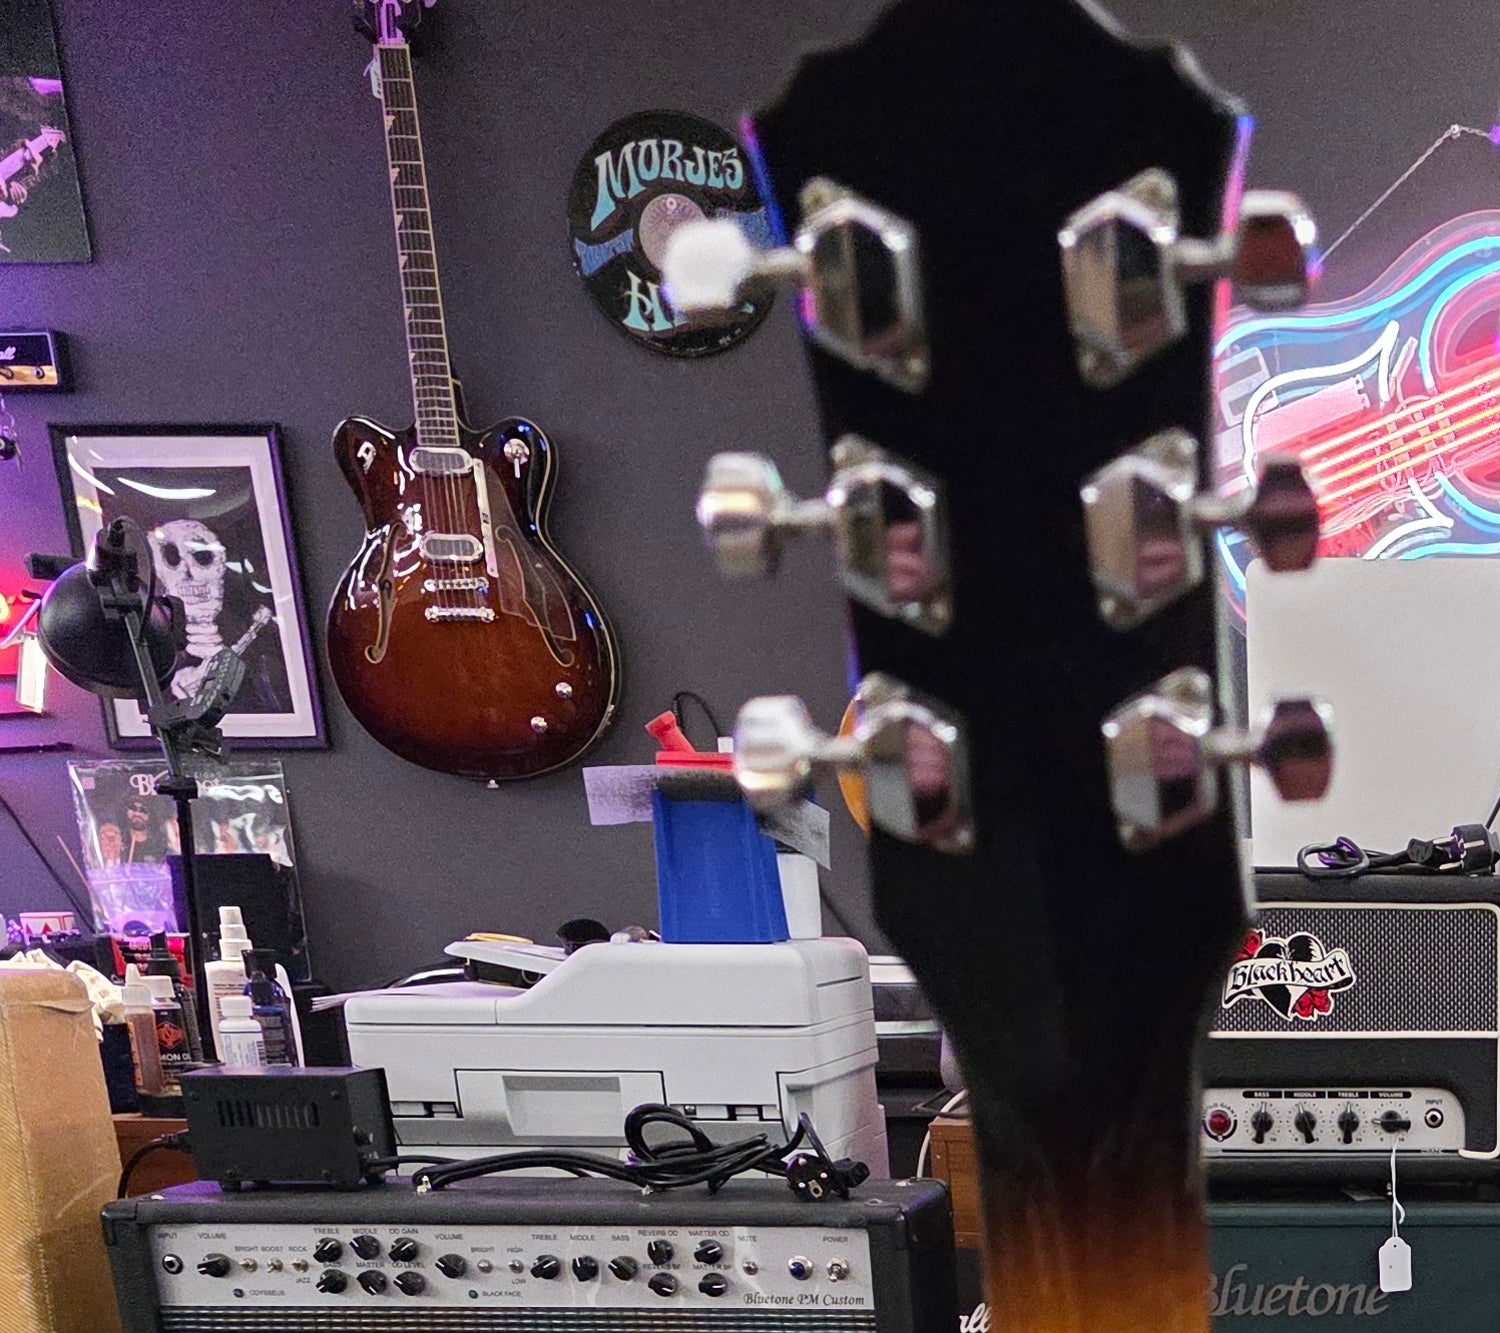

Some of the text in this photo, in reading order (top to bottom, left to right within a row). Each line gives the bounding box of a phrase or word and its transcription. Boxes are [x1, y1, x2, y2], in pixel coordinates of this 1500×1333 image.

[591, 139, 744, 231] MORJES
[1231, 956, 1346, 990] Blackheart
[434, 1233, 464, 1241] VOLUME
[743, 1293, 796, 1305] Bluetone
[823, 1293, 865, 1305] Custom
